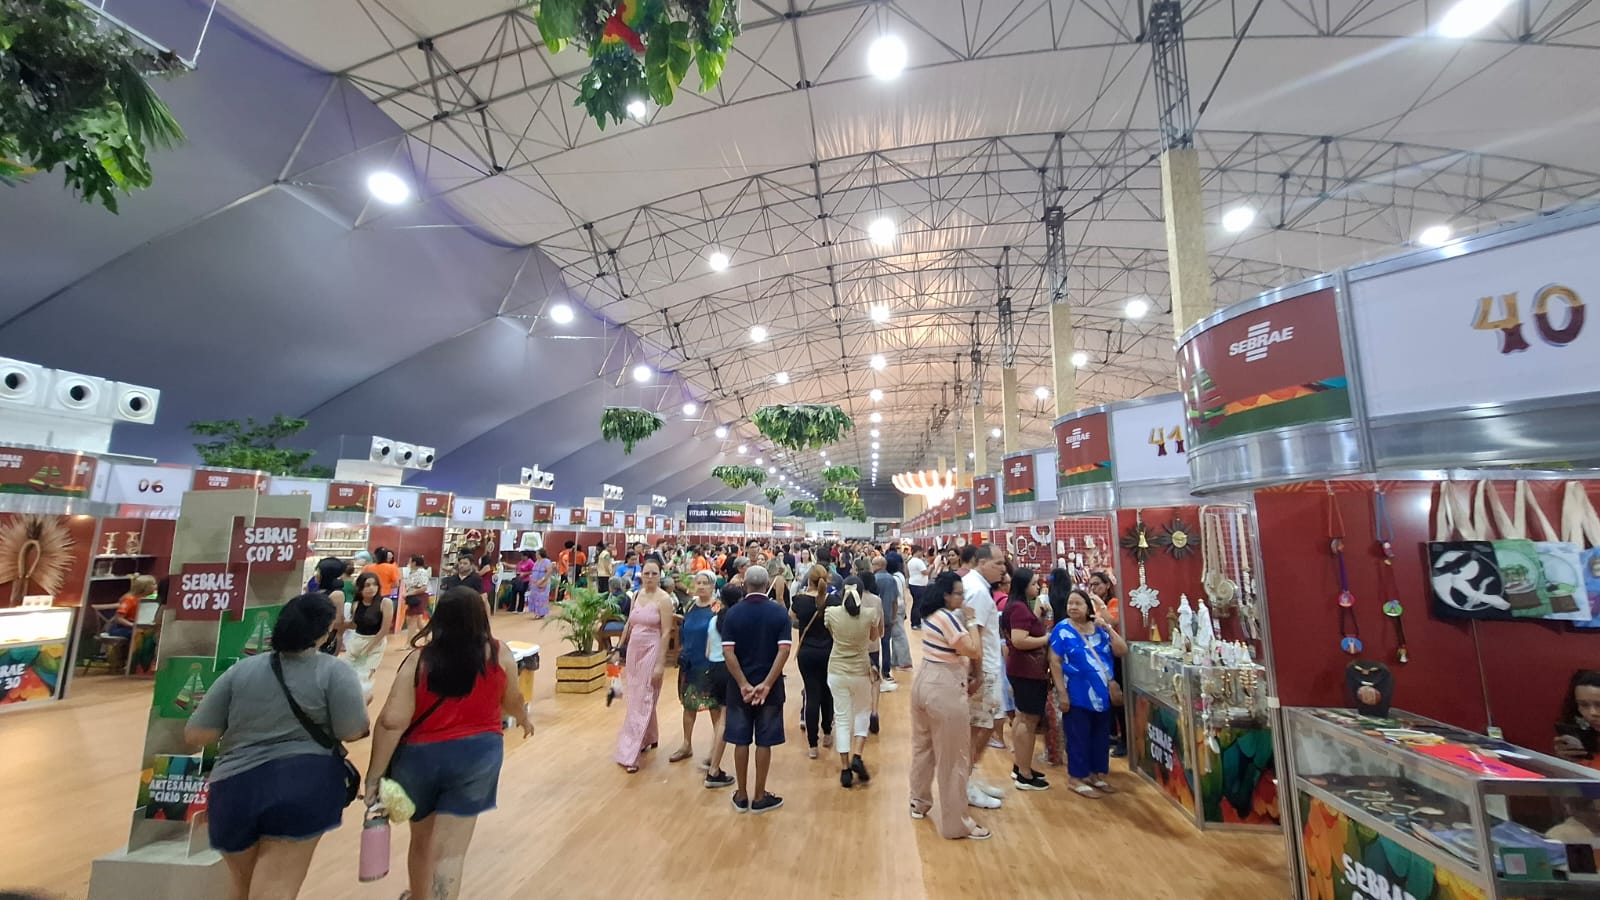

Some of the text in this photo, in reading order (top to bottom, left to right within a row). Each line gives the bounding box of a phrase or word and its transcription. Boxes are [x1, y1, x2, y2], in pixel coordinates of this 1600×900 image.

[1471, 283, 1586, 354] 40
[1229, 326, 1294, 356] SEBRAE
[1065, 431, 1091, 444] SEBRAE
[1147, 425, 1185, 456] 41
[138, 479, 164, 493] 06
[388, 499, 401, 508] 08
[245, 527, 298, 544] SEBRAE
[246, 545, 294, 562] COP 30
[182, 573, 234, 591] SEBRAE
[183, 592, 230, 610] COP 30
[1148, 722, 1174, 754] SEBRAE
[149, 780, 210, 793] ARTESANATO
[183, 793, 208, 804] 2025
